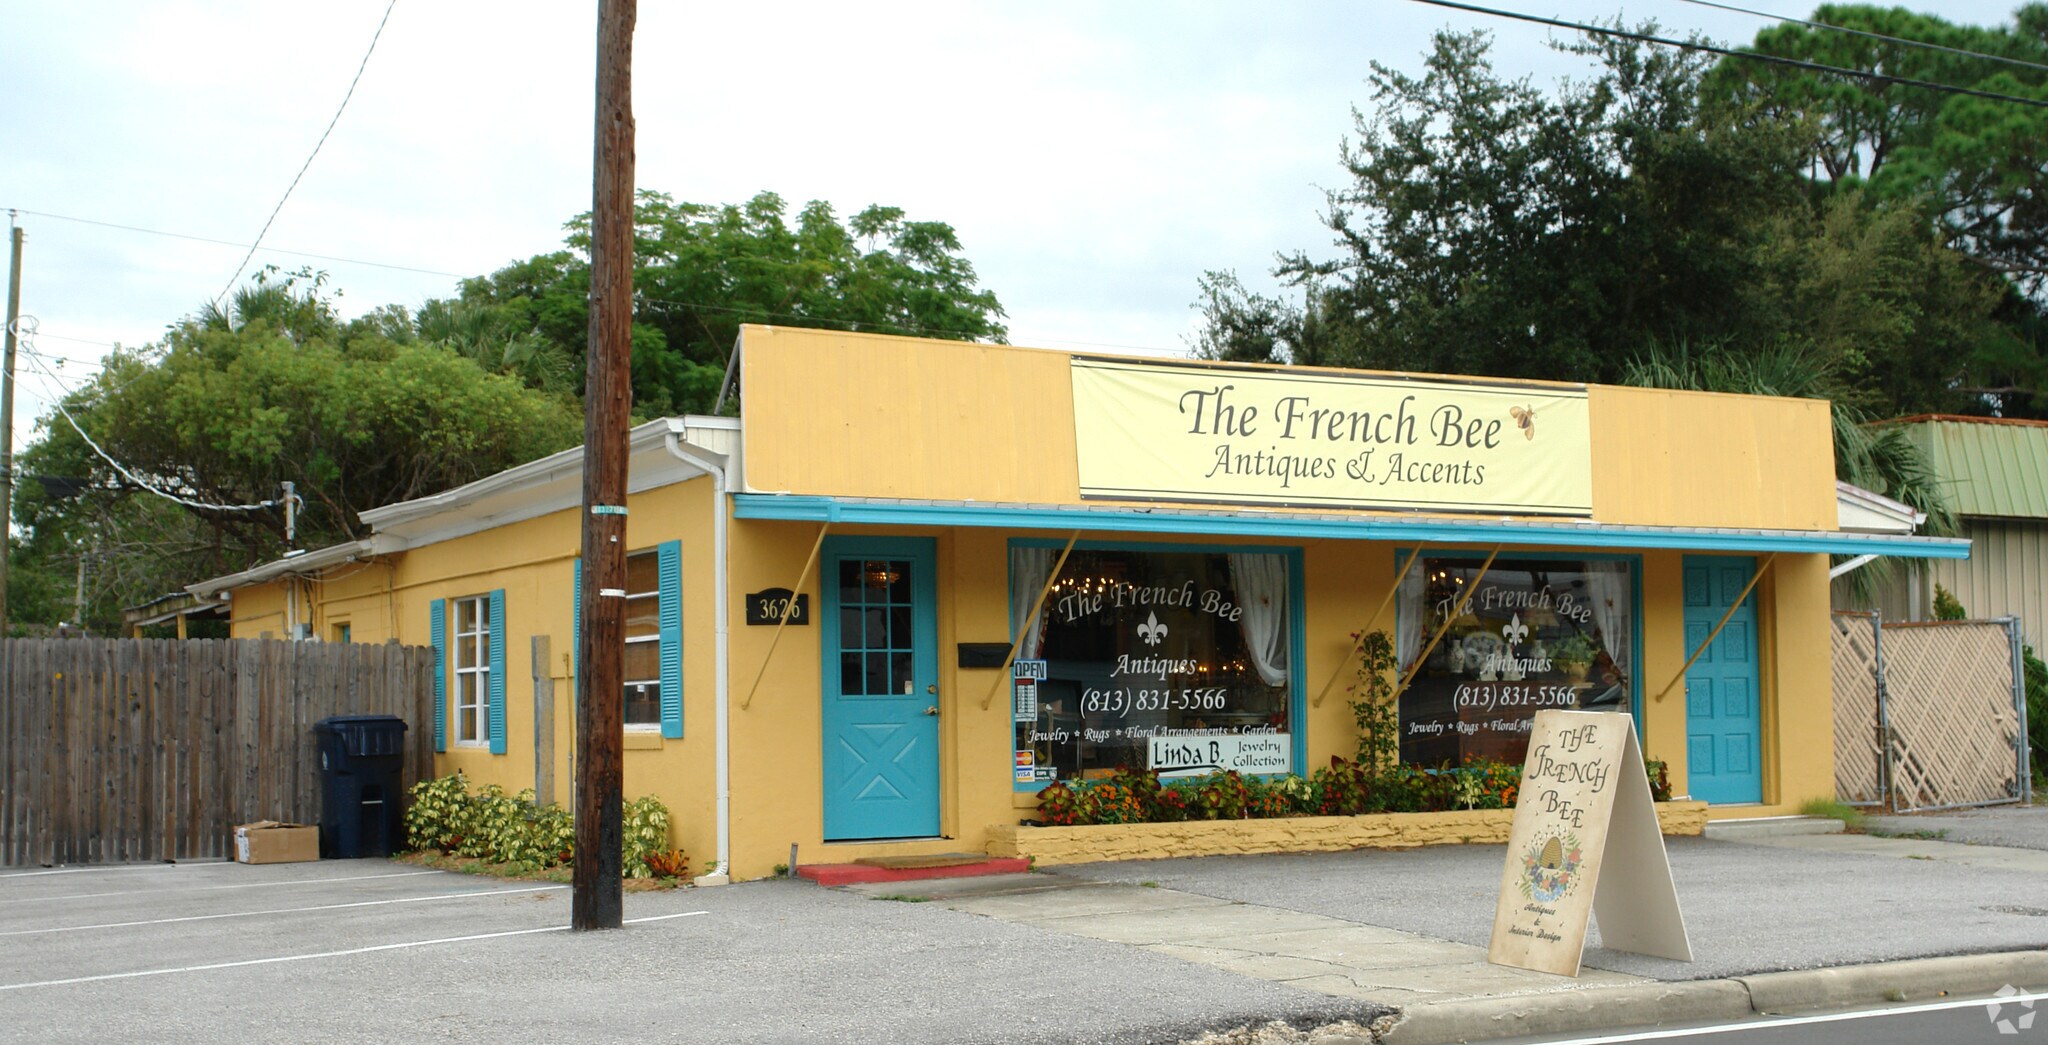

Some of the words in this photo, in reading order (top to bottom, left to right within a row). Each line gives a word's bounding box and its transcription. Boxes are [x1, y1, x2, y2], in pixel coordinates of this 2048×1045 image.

[1179, 384, 1258, 437] The
[1274, 395, 1418, 446] French
[1430, 404, 1501, 449] Bee
[1205, 444, 1335, 488] Antiques
[1346, 448, 1375, 483] &
[1378, 452, 1485, 486] Accents
[760, 598, 800, 619] 3626
[1058, 591, 1103, 622] The
[1111, 580, 1194, 608] French
[1201, 590, 1243, 622] Bee
[1480, 584, 1551, 610] French
[1555, 593, 1592, 623] Bee
[1015, 662, 1045, 678] OPEN
[1110, 654, 1197, 681] Antiques
[1480, 653, 1552, 680] Antiques
[1080, 687, 1132, 718] (813)
[1136, 688, 1226, 711] 831-5566
[1453, 684, 1497, 712] (813)
[1500, 686, 1576, 706] 831-5566
[1028, 727, 1069, 744] Jewelry
[1084, 728, 1110, 743] Rugs
[1125, 725, 1158, 739] Floral
[1160, 725, 1228, 738] Arrangements
[1242, 723, 1277, 736] Garden
[1408, 720, 1444, 736] Jewelry
[1456, 721, 1479, 735] Rugs
[1491, 719, 1517, 732] Floral
[1558, 724, 1598, 753] THE
[1154, 741, 1203, 765] Linda
[1208, 740, 1225, 764] B.
[1238, 740, 1281, 754] Jewelry
[1233, 755, 1286, 768] Collection
[1528, 744, 1611, 793] FRENCH
[1540, 789, 1584, 829] BEE
[1524, 903, 1556, 916] Antiques
[1508, 924, 1533, 937] Interior
[1536, 929, 1561, 944] Design
